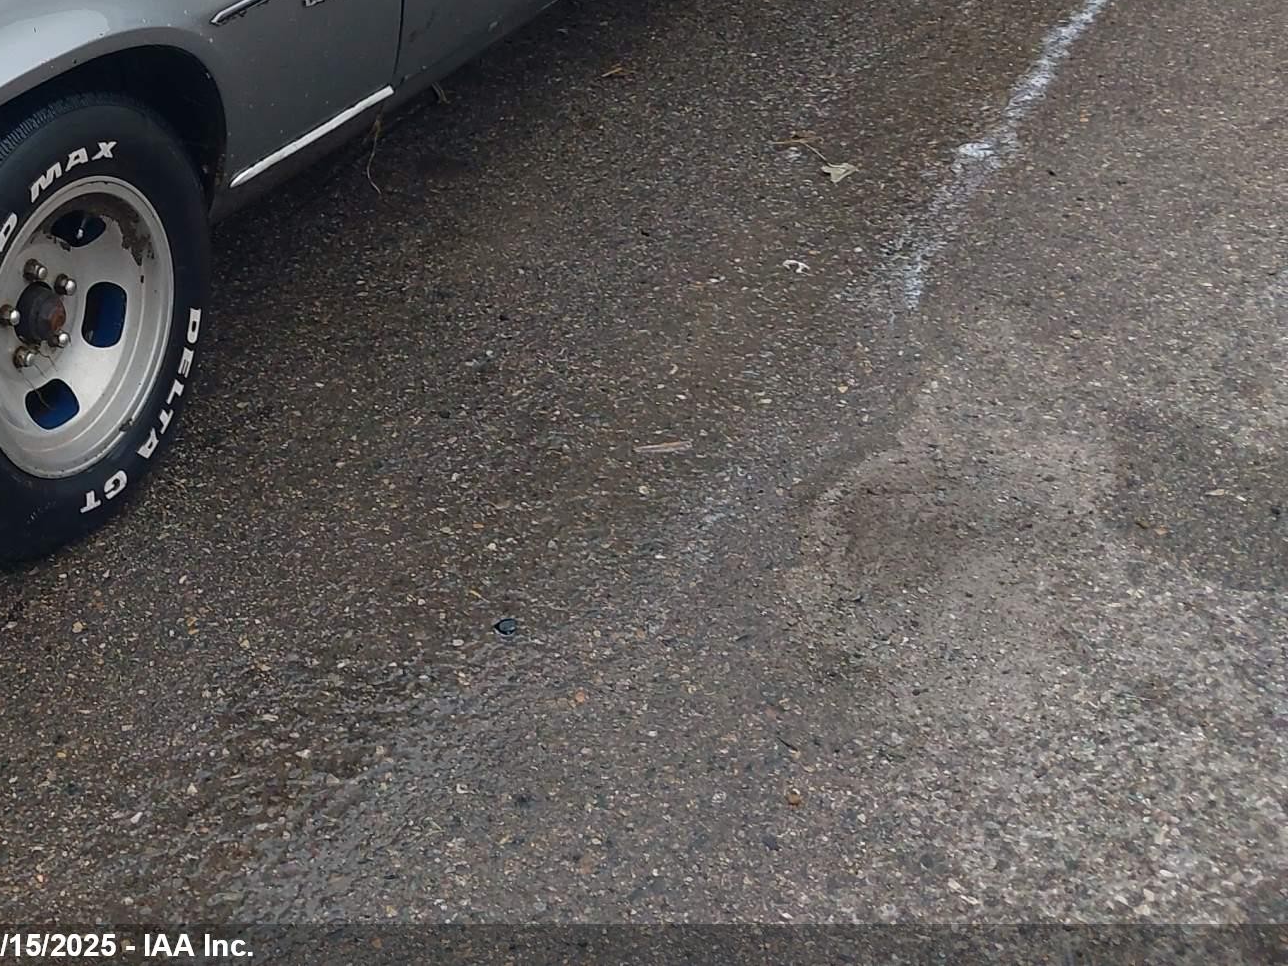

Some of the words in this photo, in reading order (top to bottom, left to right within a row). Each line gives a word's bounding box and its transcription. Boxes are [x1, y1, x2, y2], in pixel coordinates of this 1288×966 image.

[29, 140, 118, 204] MAX
[137, 306, 202, 460] DELTA
[80, 469, 128, 514] GT
